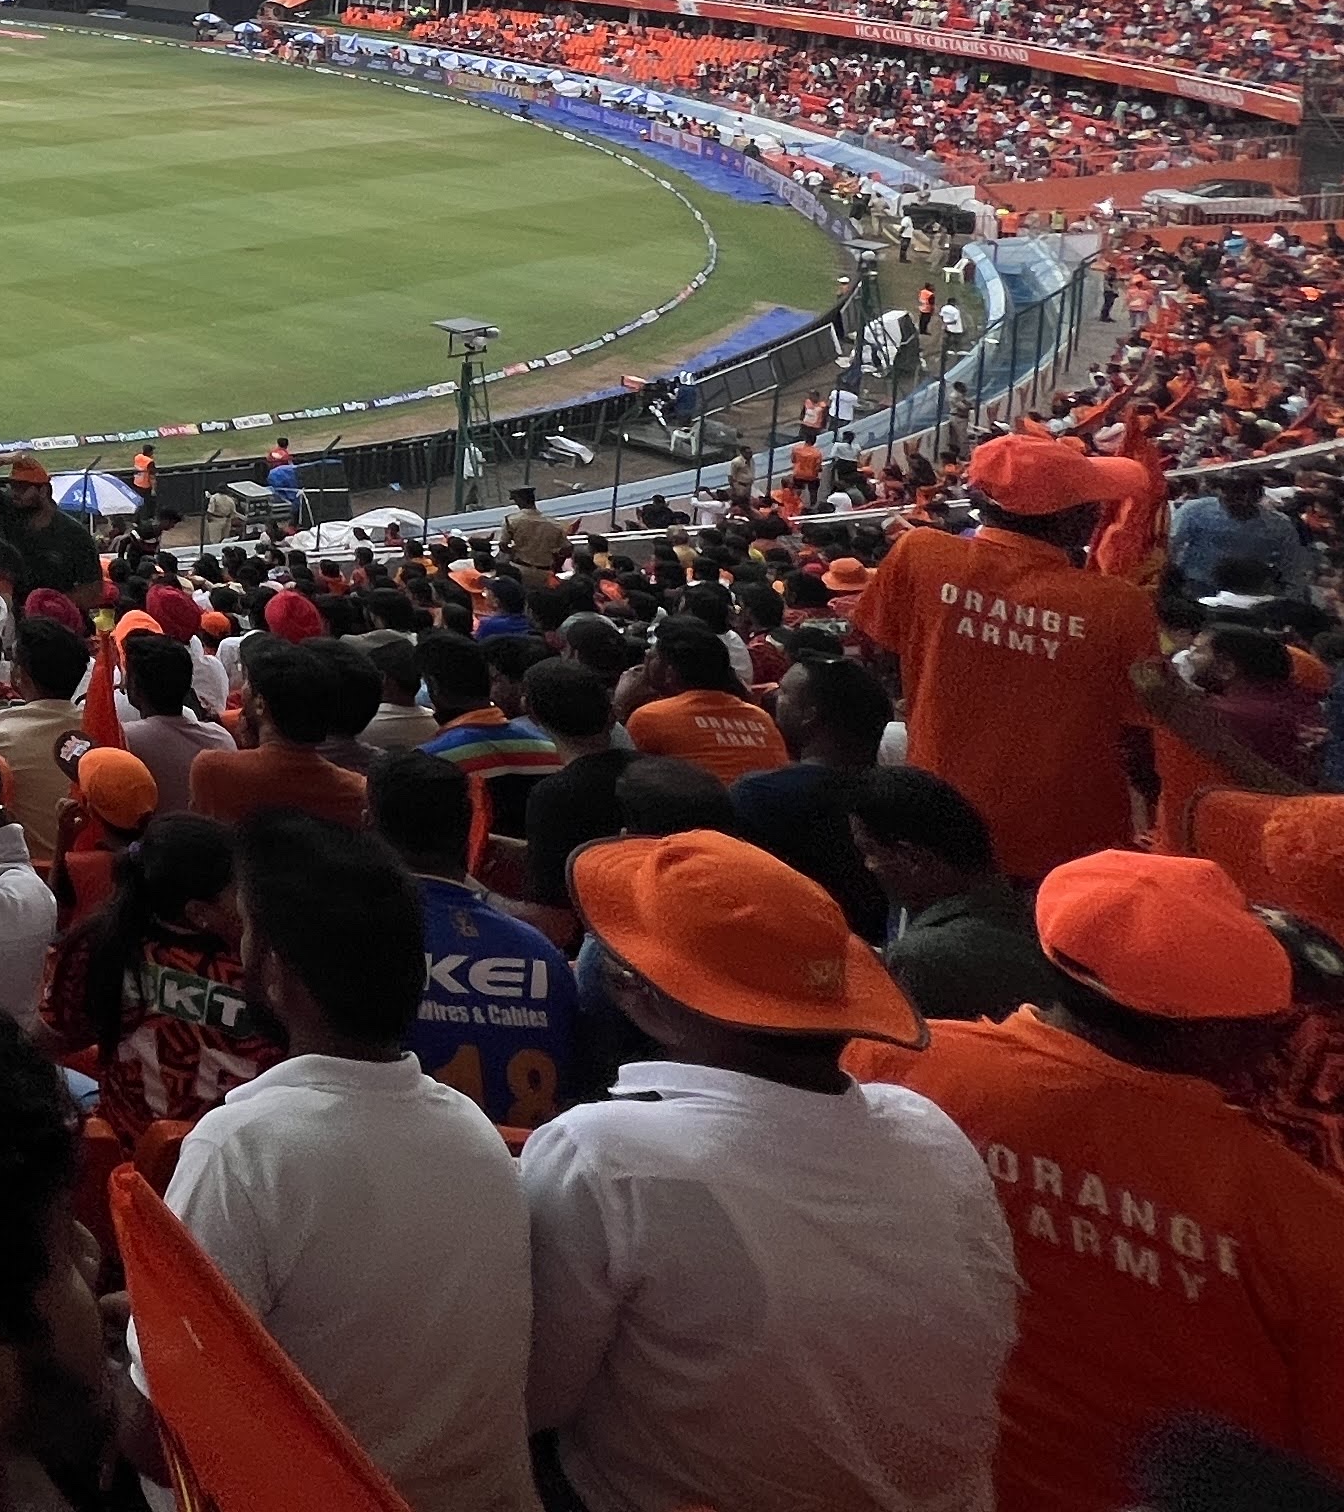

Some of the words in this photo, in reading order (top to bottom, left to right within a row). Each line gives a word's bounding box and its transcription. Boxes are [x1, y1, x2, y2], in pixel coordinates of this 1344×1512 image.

[855, 24, 881, 42] HCA
[882, 27, 911, 45] CLUB
[913, 32, 987, 56] SECRETARIES
[987, 43, 1030, 63] STAND
[940, 582, 1086, 639] ORANGE
[956, 616, 1062, 661] ARMY
[694, 715, 768, 735] ORANGE
[715, 732, 767, 749] ARMY
[424, 952, 549, 1000] KEI
[472, 1005, 487, 1024] &
[487, 1003, 549, 1028] Cables
[987, 1142, 1241, 1281] ORANGE
[1027, 1202, 1208, 1305] ARMY
